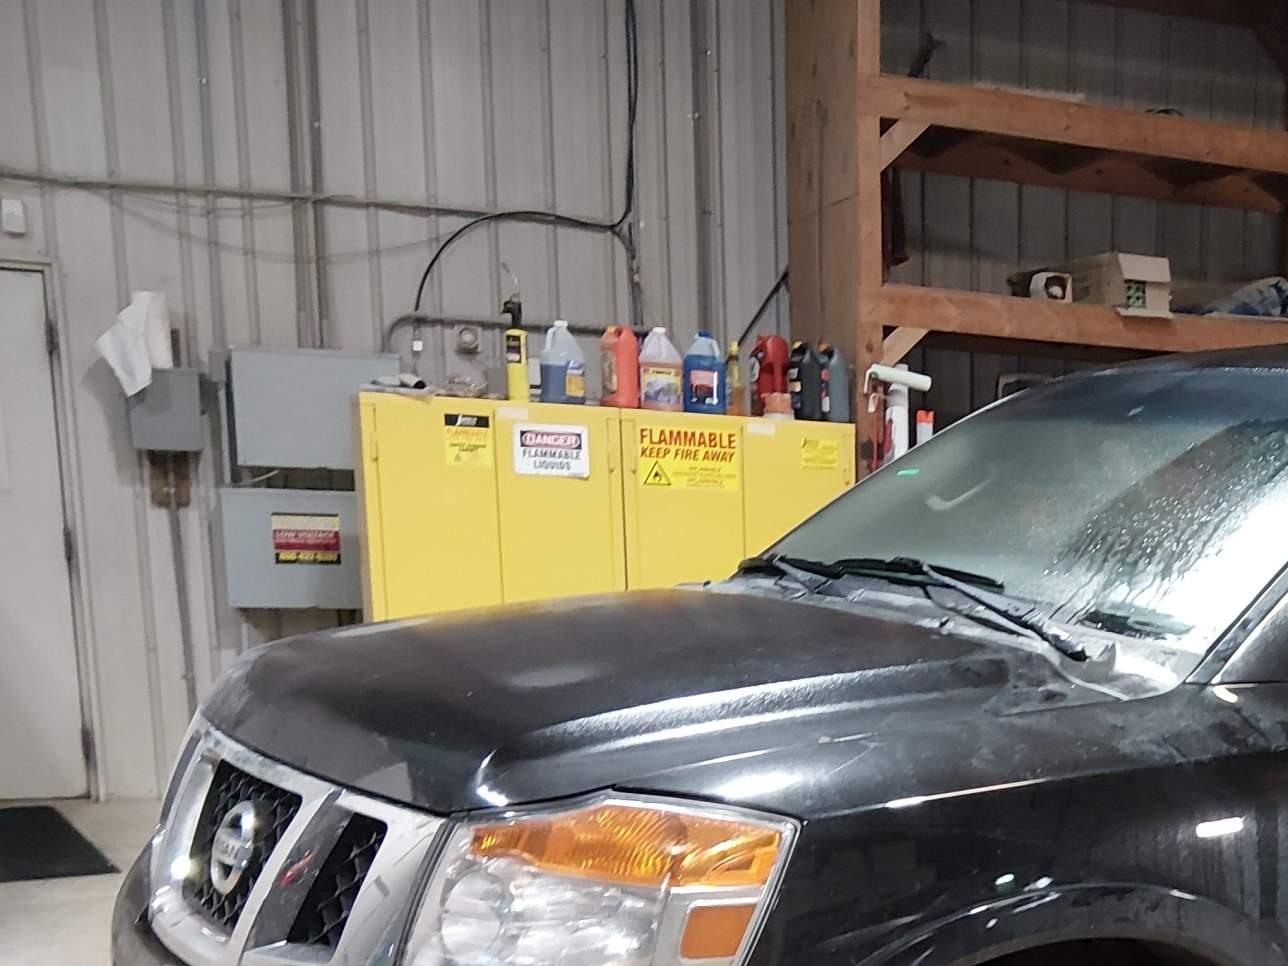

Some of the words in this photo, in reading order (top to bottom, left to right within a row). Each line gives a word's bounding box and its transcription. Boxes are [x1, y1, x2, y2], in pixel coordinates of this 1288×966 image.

[526, 432, 578, 448] DANGER
[640, 428, 737, 449] FLAMMABLE
[522, 448, 581, 460] FLAMMABLE
[640, 446, 671, 459] KEEP
[673, 448, 700, 461] FIRE
[702, 450, 736, 462] AWAY
[533, 459, 572, 471] LIQUIDS
